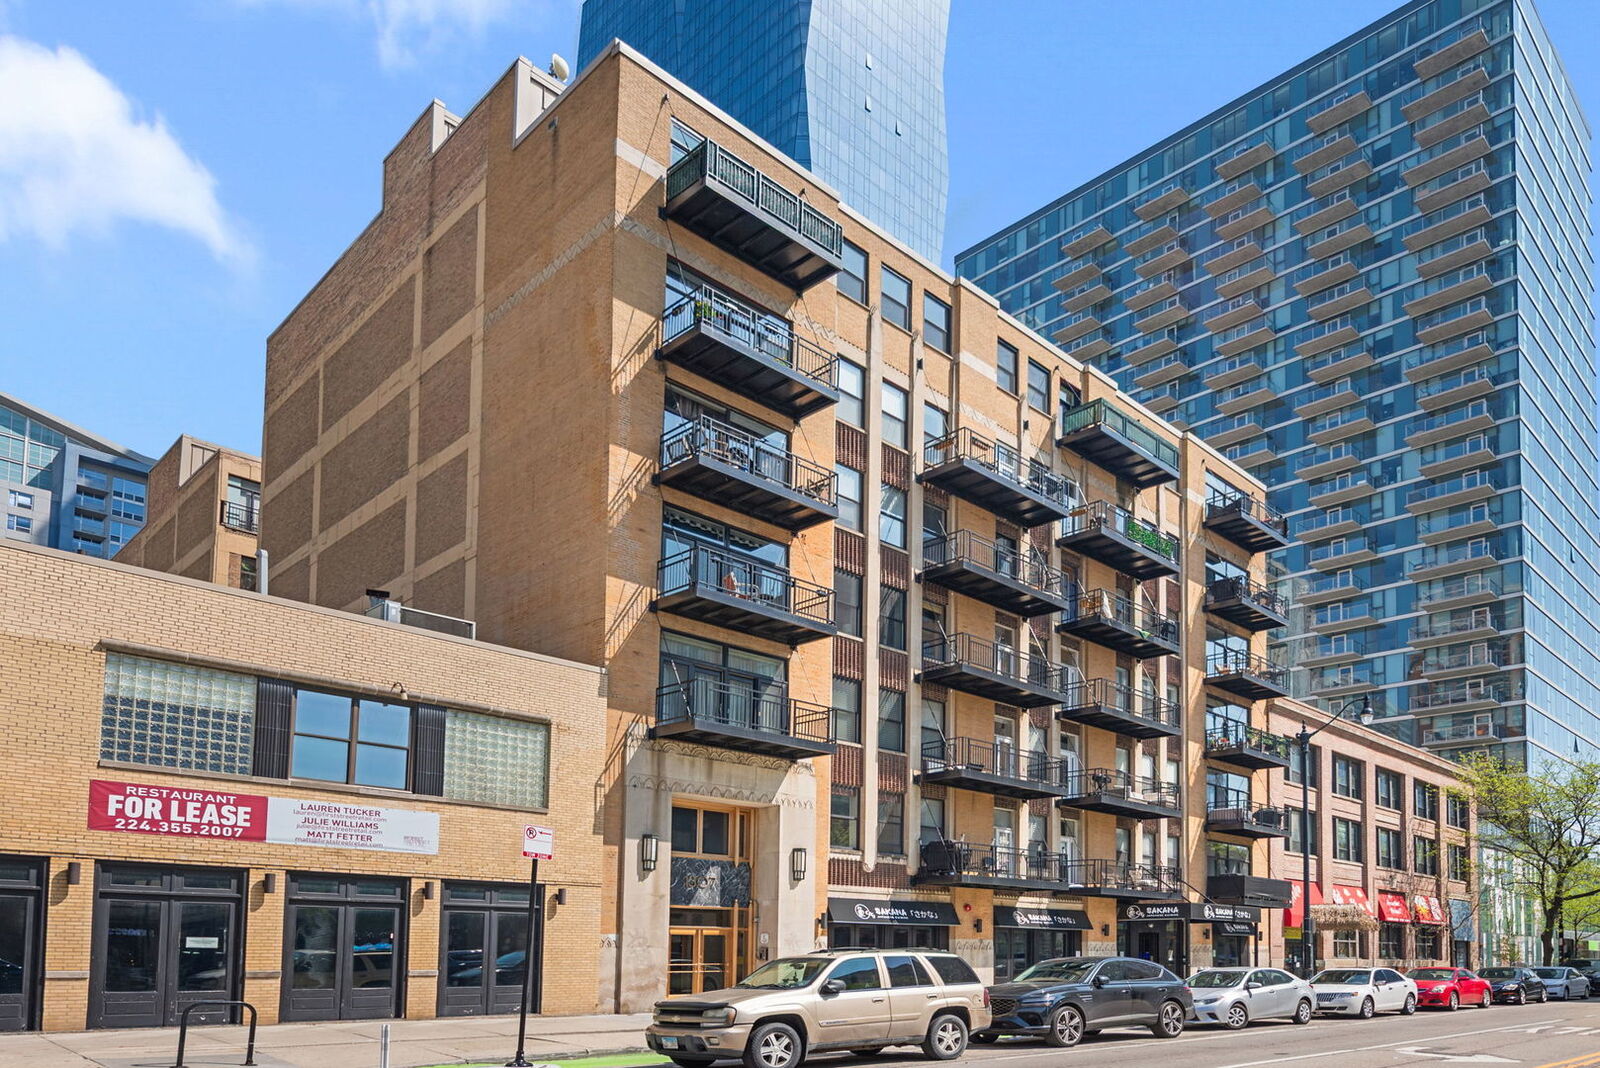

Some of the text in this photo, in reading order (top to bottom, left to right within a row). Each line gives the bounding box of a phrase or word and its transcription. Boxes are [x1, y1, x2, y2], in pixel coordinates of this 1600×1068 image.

[126, 786, 237, 804] RESTAURANT
[107, 794, 251, 827] FOR LEASE
[300, 803, 381, 817] LAUREN TUCKER
[115, 818, 243, 837] 224.355.2007
[301, 817, 379, 830] JULIE WILLIAMS
[306, 831, 373, 842] MATT FETTER
[874, 907, 907, 917] SAKANA
[1146, 906, 1179, 914] SAKANA
[1215, 908, 1233, 916] SAKANA
[1027, 913, 1053, 922] SAKANA
